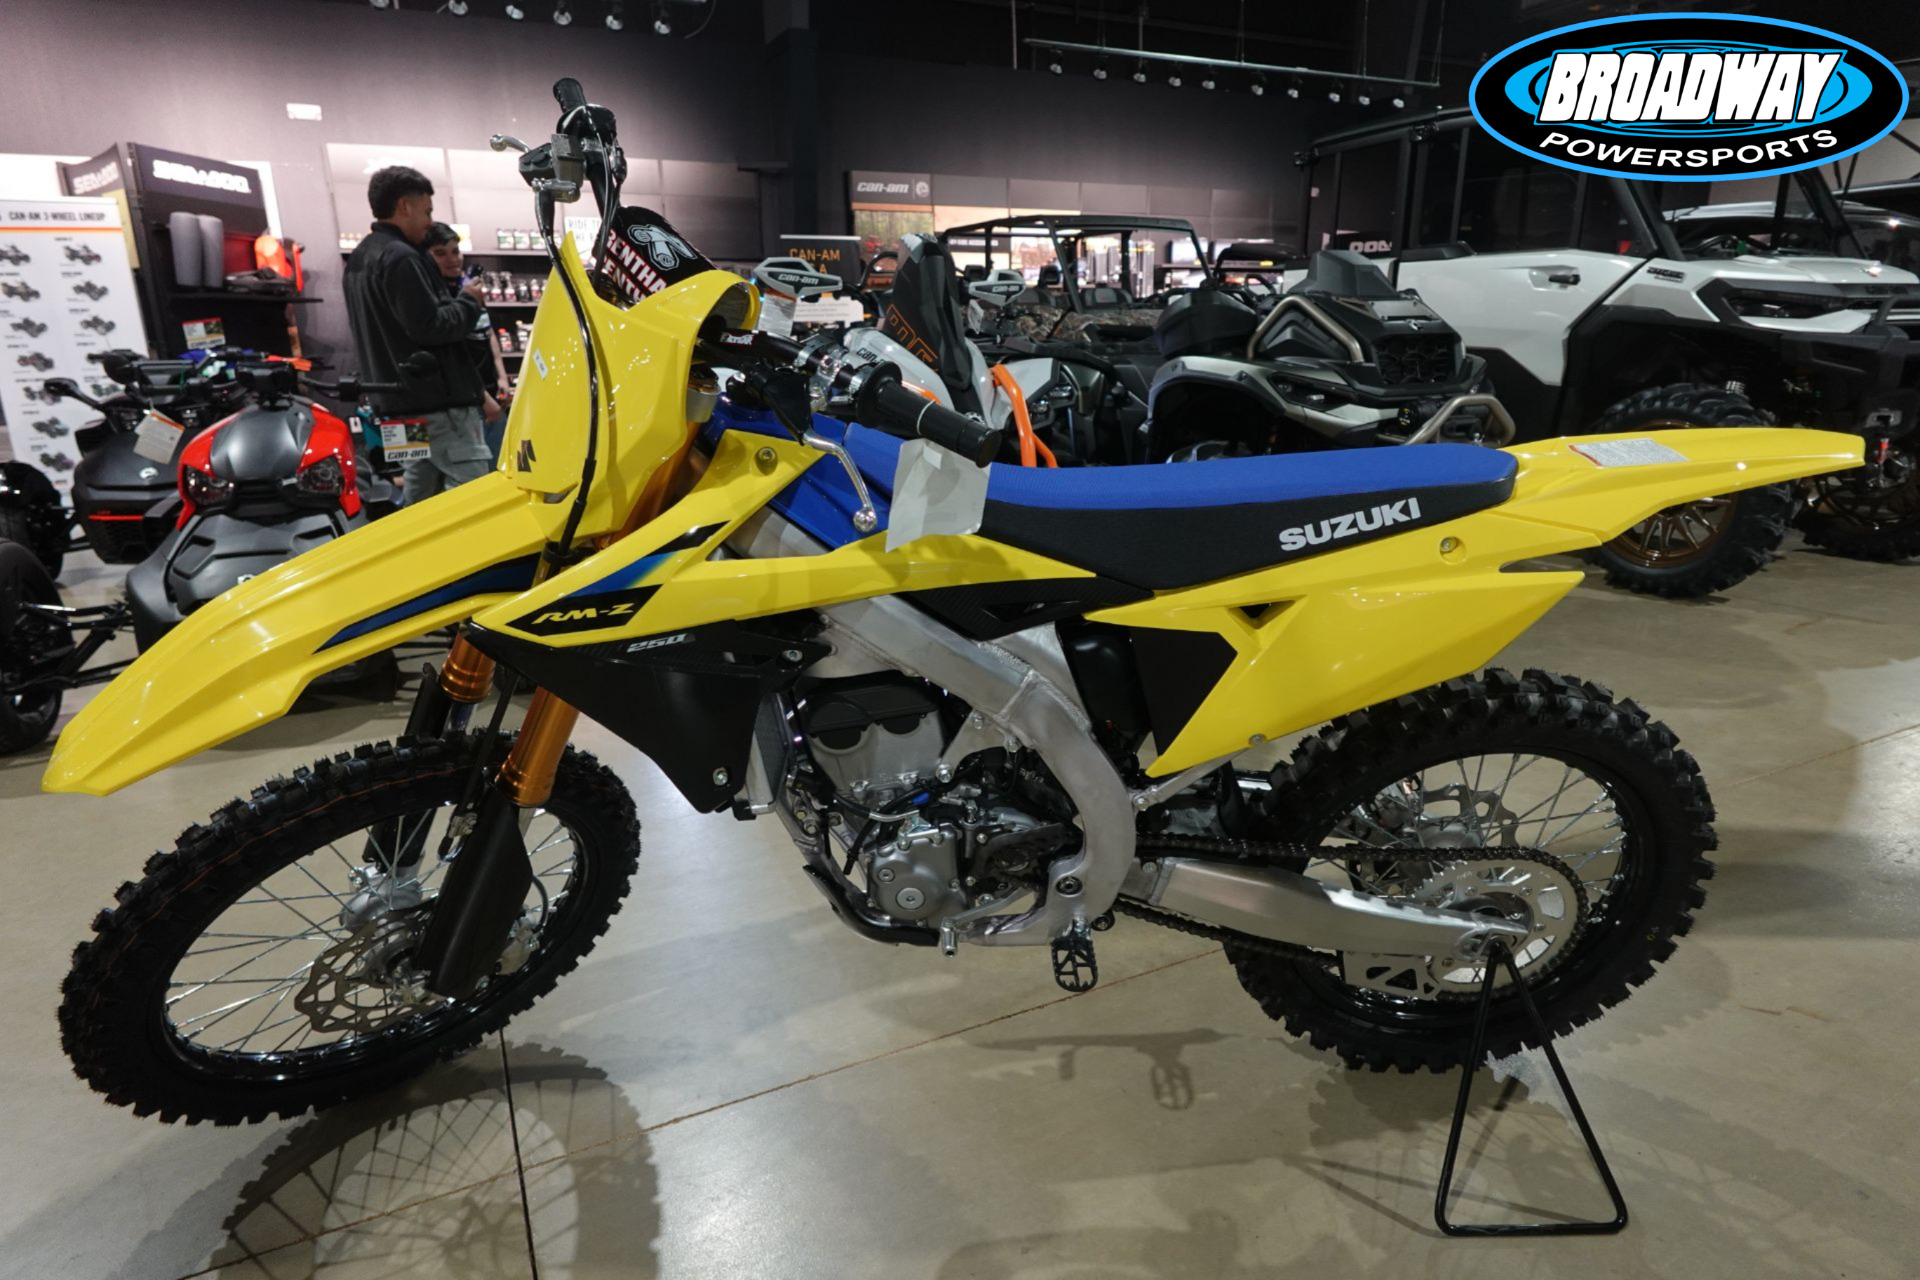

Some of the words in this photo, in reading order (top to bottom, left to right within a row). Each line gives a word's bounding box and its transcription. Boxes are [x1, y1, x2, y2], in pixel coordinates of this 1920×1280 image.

[856, 181, 910, 193] can-am
[788, 248, 841, 261] CAN-AM
[777, 273, 820, 285] can-am
[855, 346, 888, 365] can-
[387, 449, 429, 461] can-am
[1278, 497, 1422, 551] SUZUKI
[531, 602, 635, 625] RM-Z
[626, 633, 688, 653] 250
